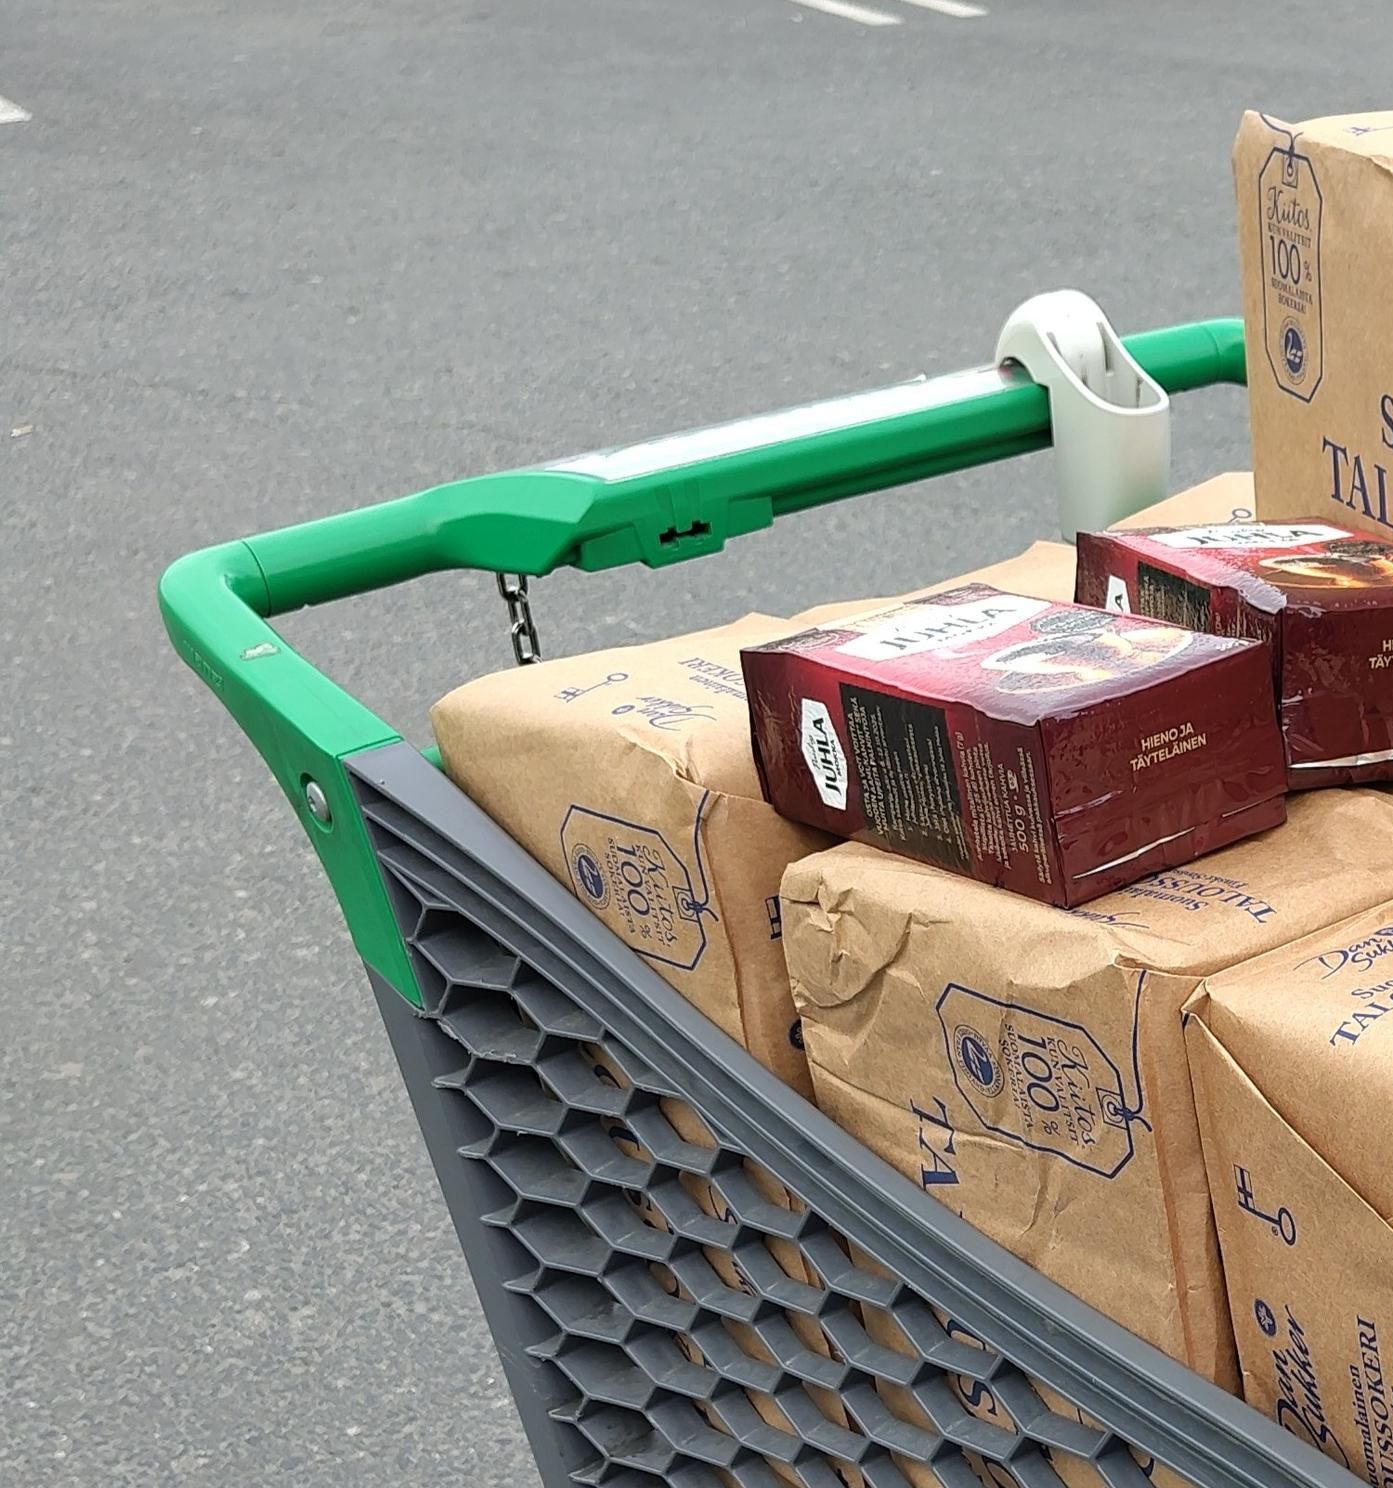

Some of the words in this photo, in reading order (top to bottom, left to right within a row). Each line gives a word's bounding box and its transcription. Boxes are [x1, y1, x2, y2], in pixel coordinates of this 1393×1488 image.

[1270, 235, 1302, 285] 100
[823, 716, 842, 797] JUHLA
[1130, 733, 1208, 772] TÄYTELÄINEN
[1140, 726, 1177, 750] HIENO
[1178, 722, 1195, 738] JA
[862, 790, 874, 818] OSTA
[1013, 803, 1026, 817] g
[1013, 816, 1030, 853] 500
[617, 844, 650, 916] 100
[639, 924, 652, 939] %
[1293, 936, 1384, 981] Dan
[1004, 1022, 1035, 1129] SUOMALAISTA
[1017, 1033, 1061, 1113] 100
[1041, 1119, 1061, 1137] %
[1046, 1036, 1061, 1069] KUN
[1054, 1075, 1080, 1147] VALITSIT
[1284, 1304, 1350, 1470] Sukker
